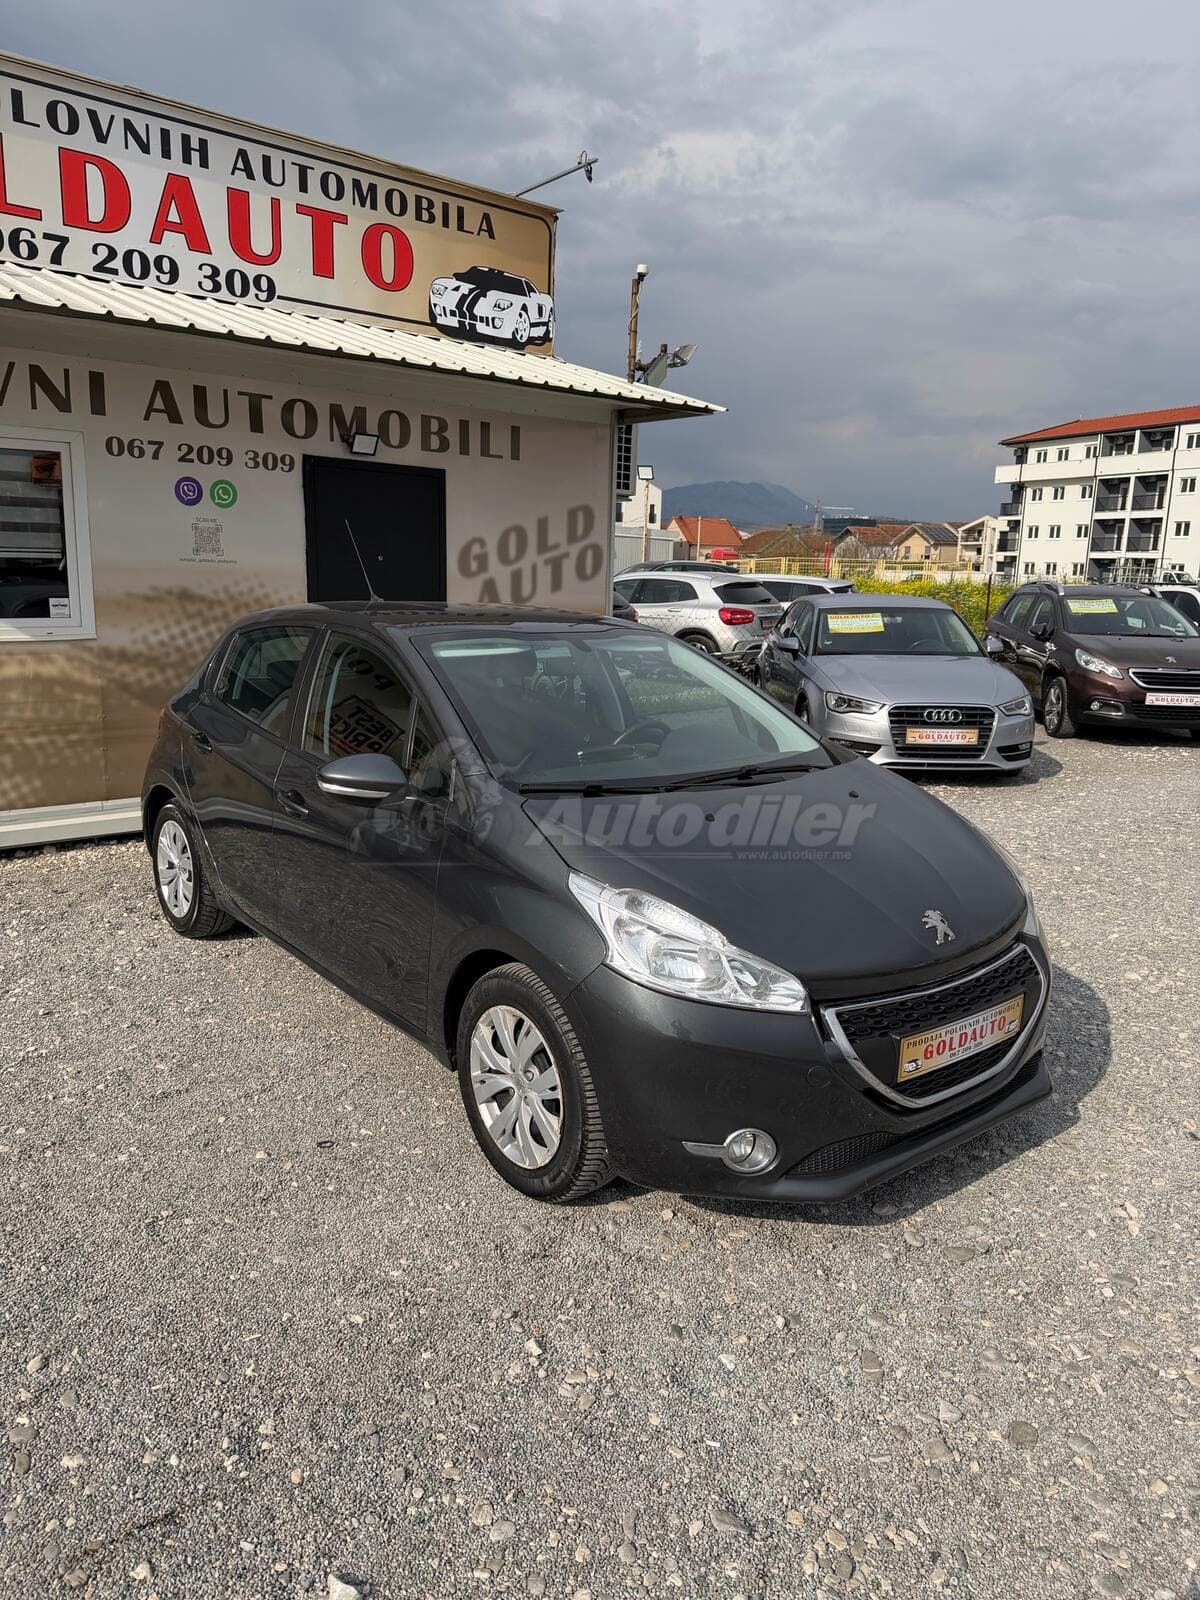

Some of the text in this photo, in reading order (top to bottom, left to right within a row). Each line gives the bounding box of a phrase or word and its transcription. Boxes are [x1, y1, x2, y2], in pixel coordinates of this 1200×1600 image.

[230, 147, 497, 241] AUTOMOBILA
[0, 226, 277, 303] 67 209 309
[143, 378, 522, 462] AUTOMOBILI
[105, 435, 296, 474] 067 209 309
[457, 504, 595, 579] GOLD
[478, 542, 604, 604] AUTO
[918, 733, 967, 741] GOLDAUTO
[906, 1030, 943, 1050] PRODAJA
[944, 1017, 980, 1037] POLOVNIH
[923, 1015, 1007, 1061] GOLDAUTO
